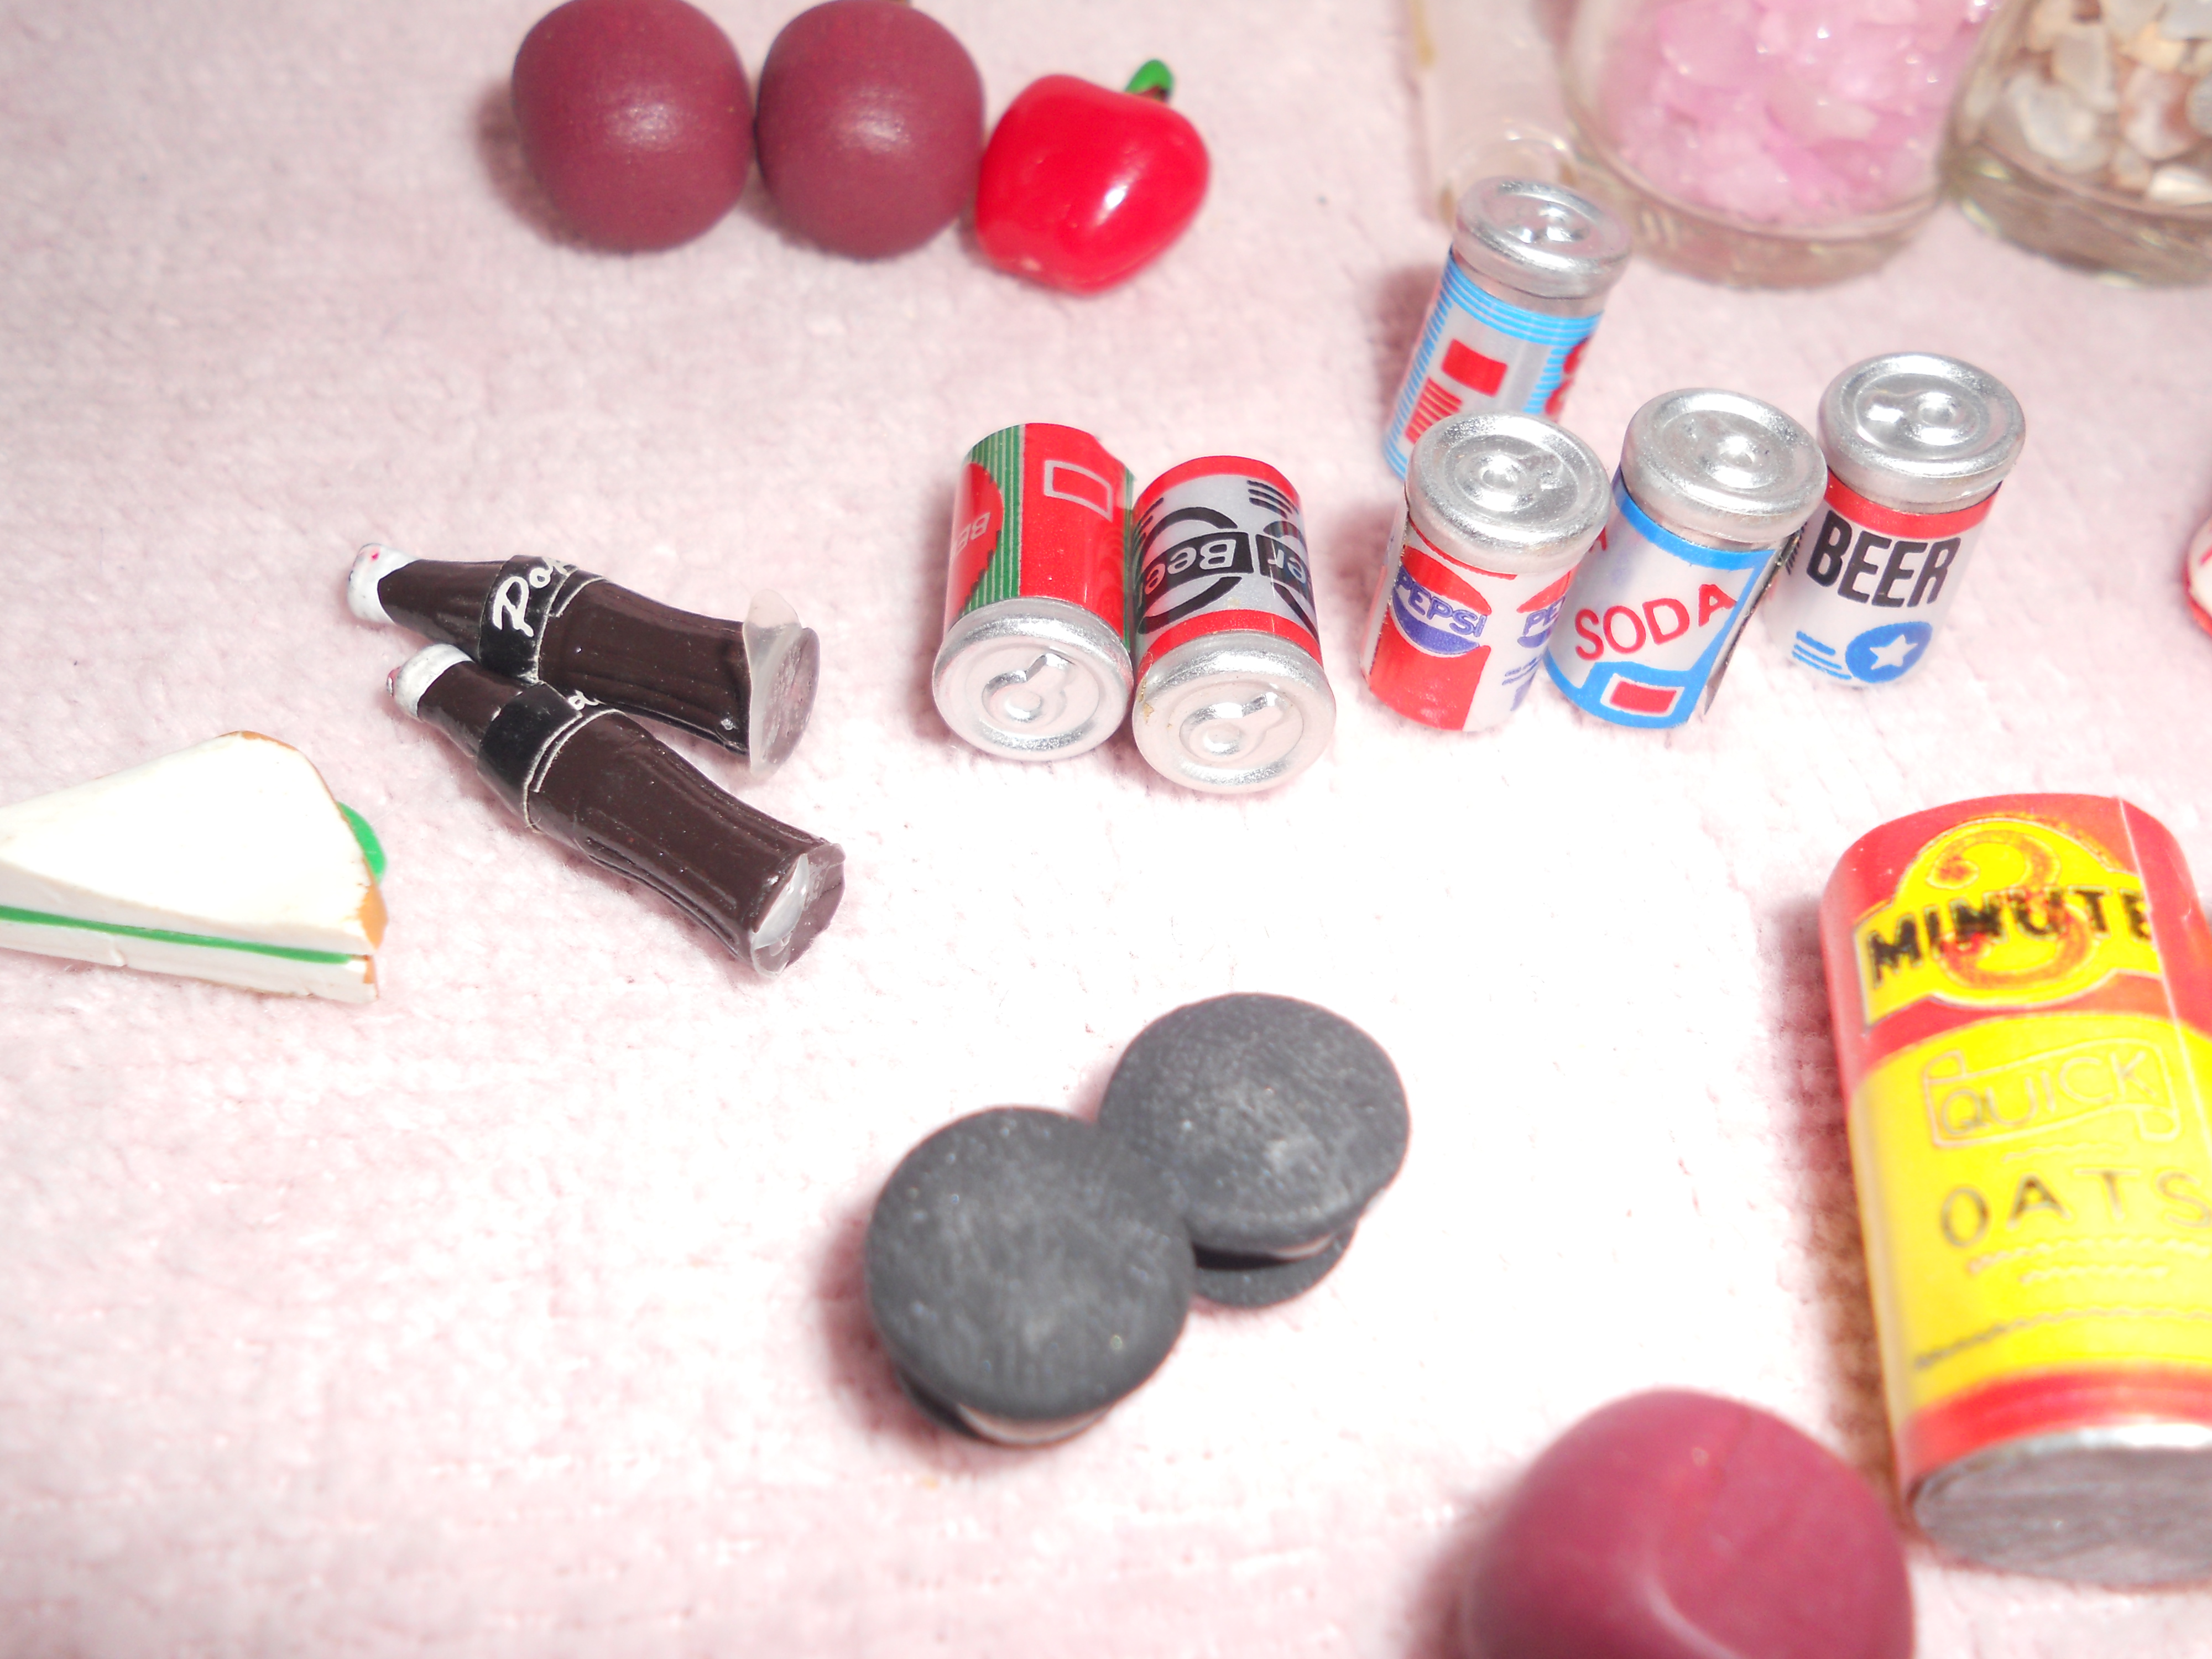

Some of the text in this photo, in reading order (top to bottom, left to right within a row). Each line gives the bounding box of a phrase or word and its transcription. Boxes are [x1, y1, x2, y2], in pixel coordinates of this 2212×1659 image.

[951, 512, 991, 559] BE
[1142, 539, 1237, 598] Bee
[1806, 509, 1961, 608] BEER
[1394, 565, 1488, 638] PEPSI
[1574, 583, 1738, 660] SODA
[1939, 1050, 2158, 1137] QUICK
[1939, 1166, 2212, 1250] OATS
